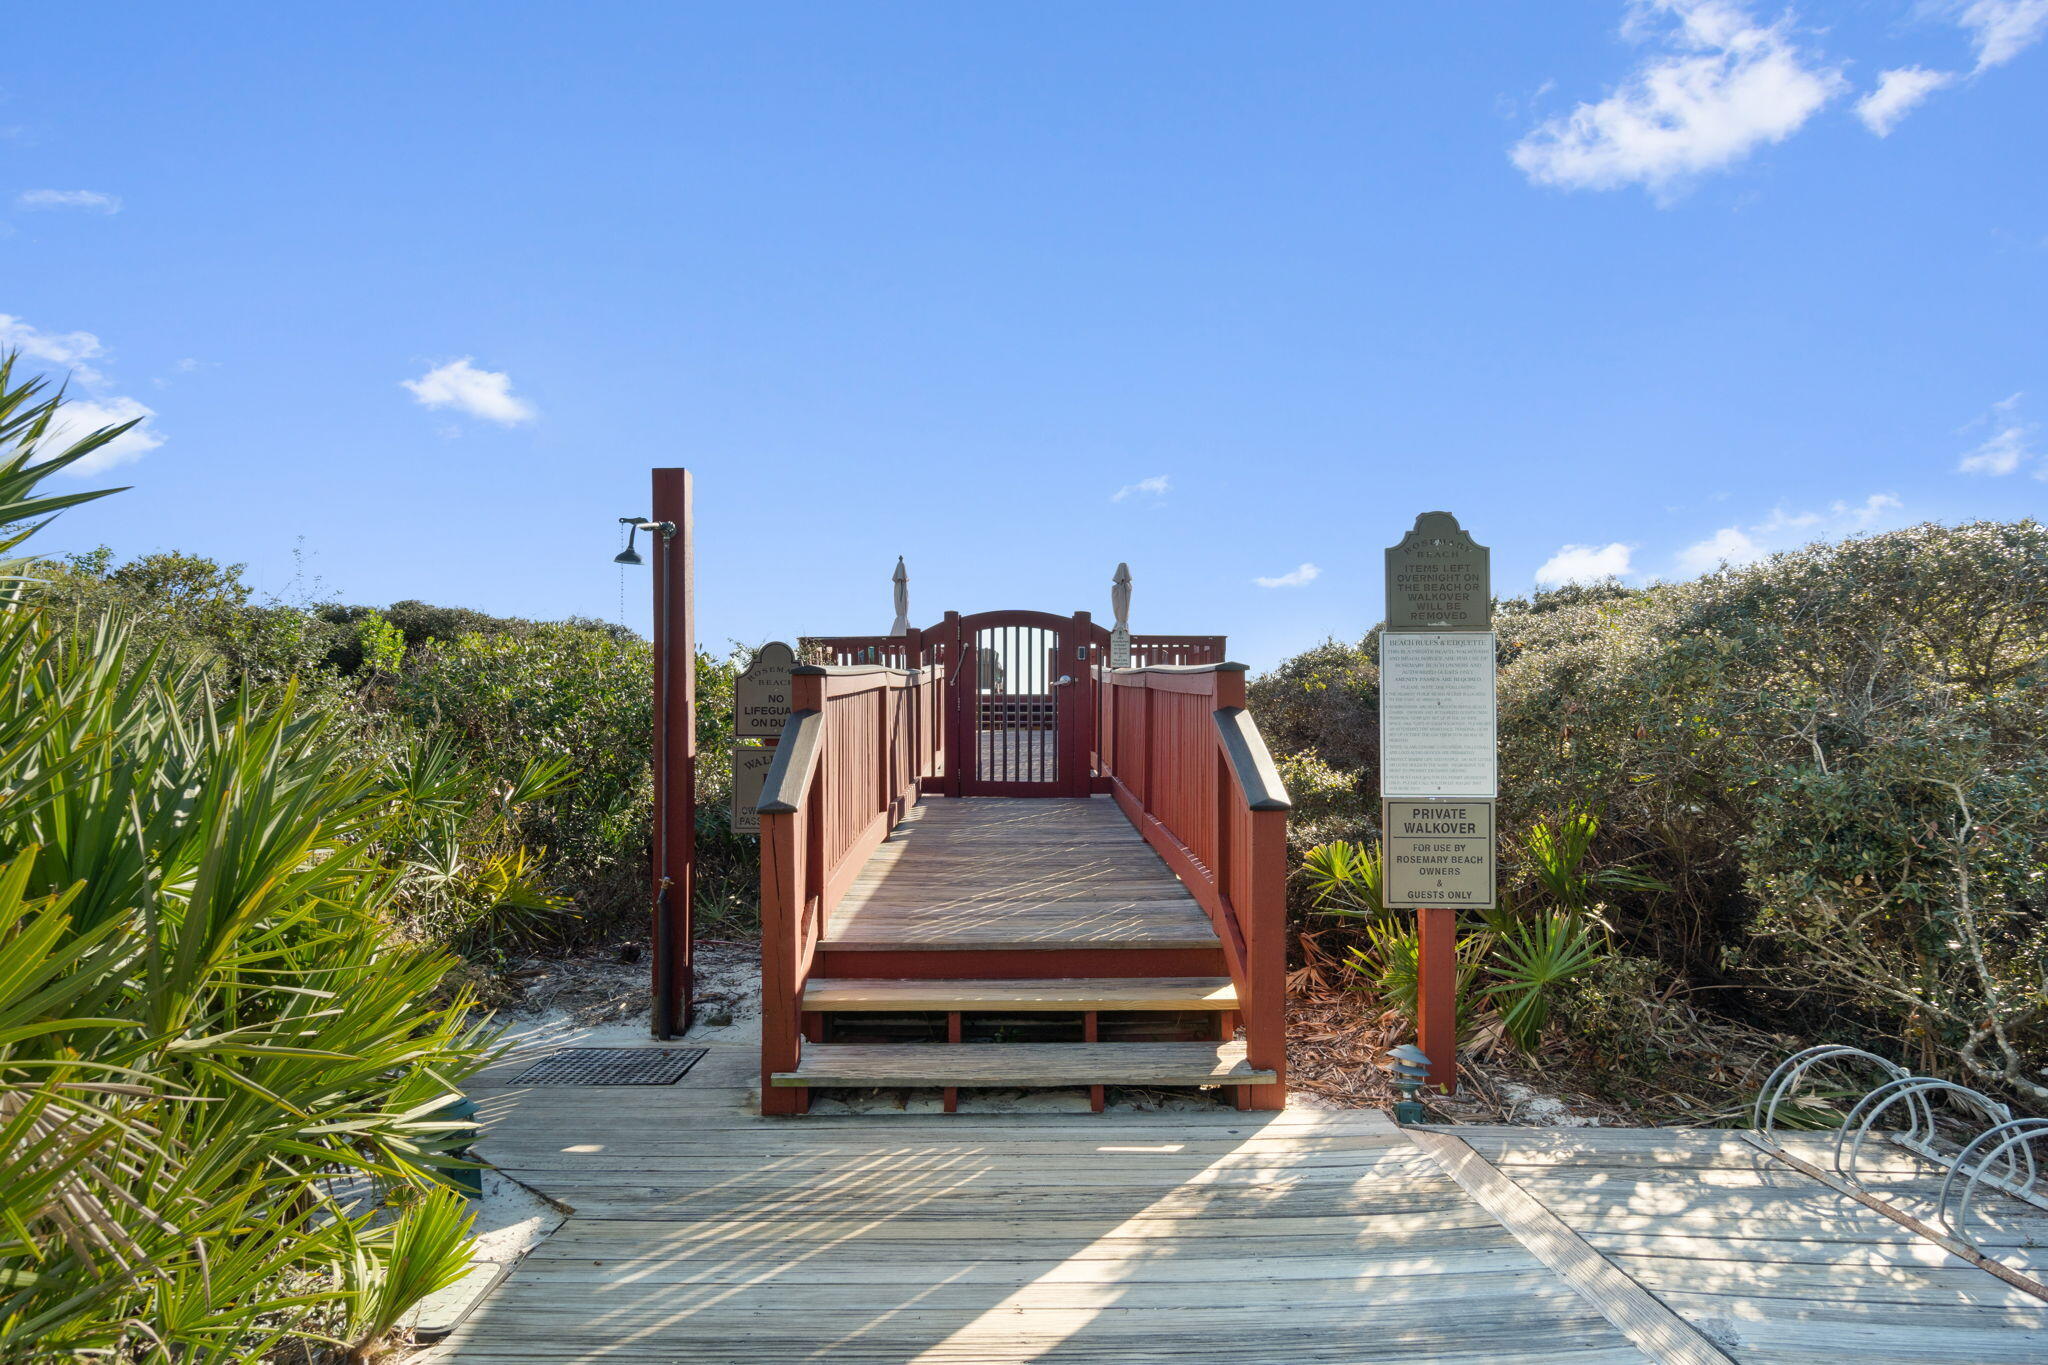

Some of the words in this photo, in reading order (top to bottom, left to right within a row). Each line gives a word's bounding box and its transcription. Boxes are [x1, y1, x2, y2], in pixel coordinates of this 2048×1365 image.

[1417, 551, 1459, 559] BEACH
[1404, 564, 1439, 573] ITEMS
[1443, 564, 1472, 573] LEFT
[1396, 574, 1462, 583] OVERNIGHT
[1463, 573, 1479, 582] ON
[1397, 583, 1420, 592] THE
[1423, 583, 1462, 592] BEACH
[1464, 583, 1480, 592] OR
[1407, 592, 1470, 601] WALKOVER
[1416, 602, 1443, 611] WILL
[1446, 602, 1462, 611] BE
[1410, 612, 1468, 620] REMOVED
[1389, 639, 1415, 647] BEACH
[768, 694, 785, 703] NO
[751, 718, 768, 728] ON
[1412, 808, 1467, 820] PRIVATE
[1403, 822, 1477, 834] WALKOVER
[1413, 844, 1431, 852] FOR
[1433, 844, 1451, 852] USE
[1454, 844, 1467, 852] BY
[1396, 855, 1449, 864] ROSEMARY
[1451, 856, 1483, 864] BEACH
[1419, 867, 1461, 876] OWNERS
[1436, 879, 1443, 888] &
[1407, 890, 1445, 899] GUESTS
[1447, 890, 1473, 899] ONLY
